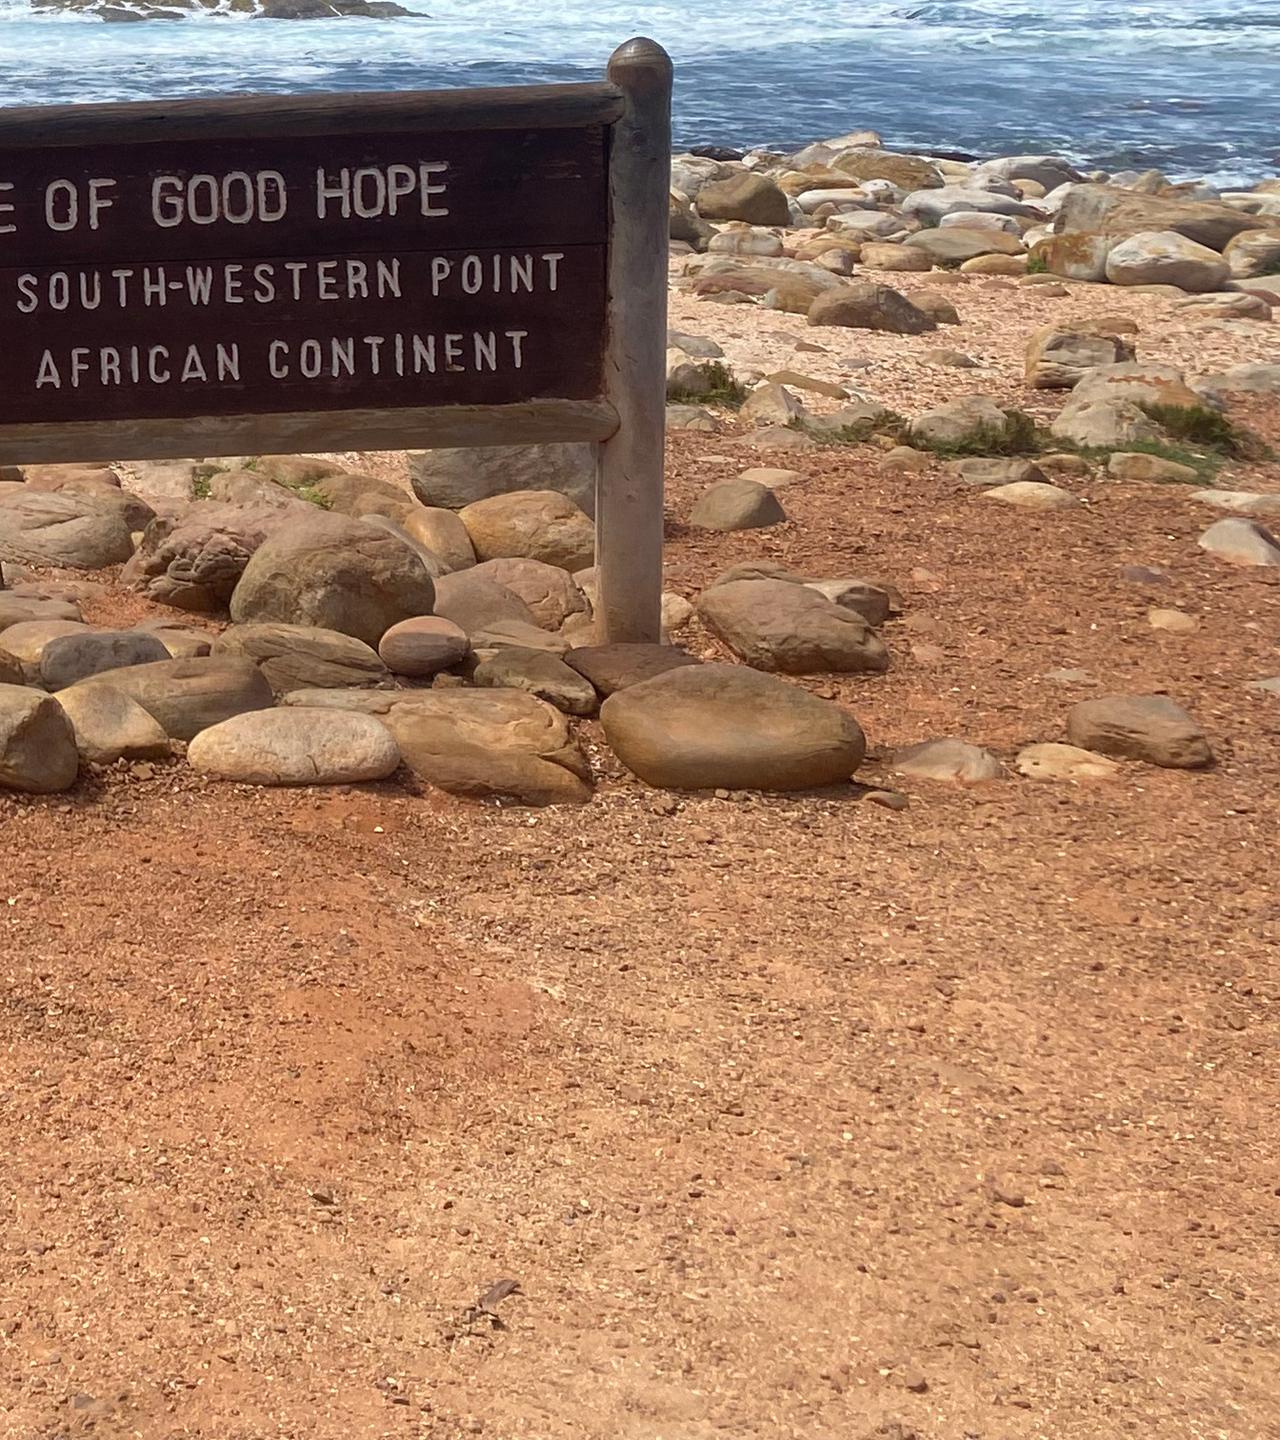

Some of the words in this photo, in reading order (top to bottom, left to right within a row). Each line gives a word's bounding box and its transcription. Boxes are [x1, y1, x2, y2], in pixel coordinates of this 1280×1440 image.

[44, 177, 118, 232] OF
[150, 169, 288, 229] GOOD
[315, 163, 450, 220] HOPE
[15, 257, 403, 315] SOUTH-WESTERN
[430, 252, 566, 298] POINT
[34, 339, 241, 390] AFRICAN
[268, 330, 529, 380] CONTINENT
